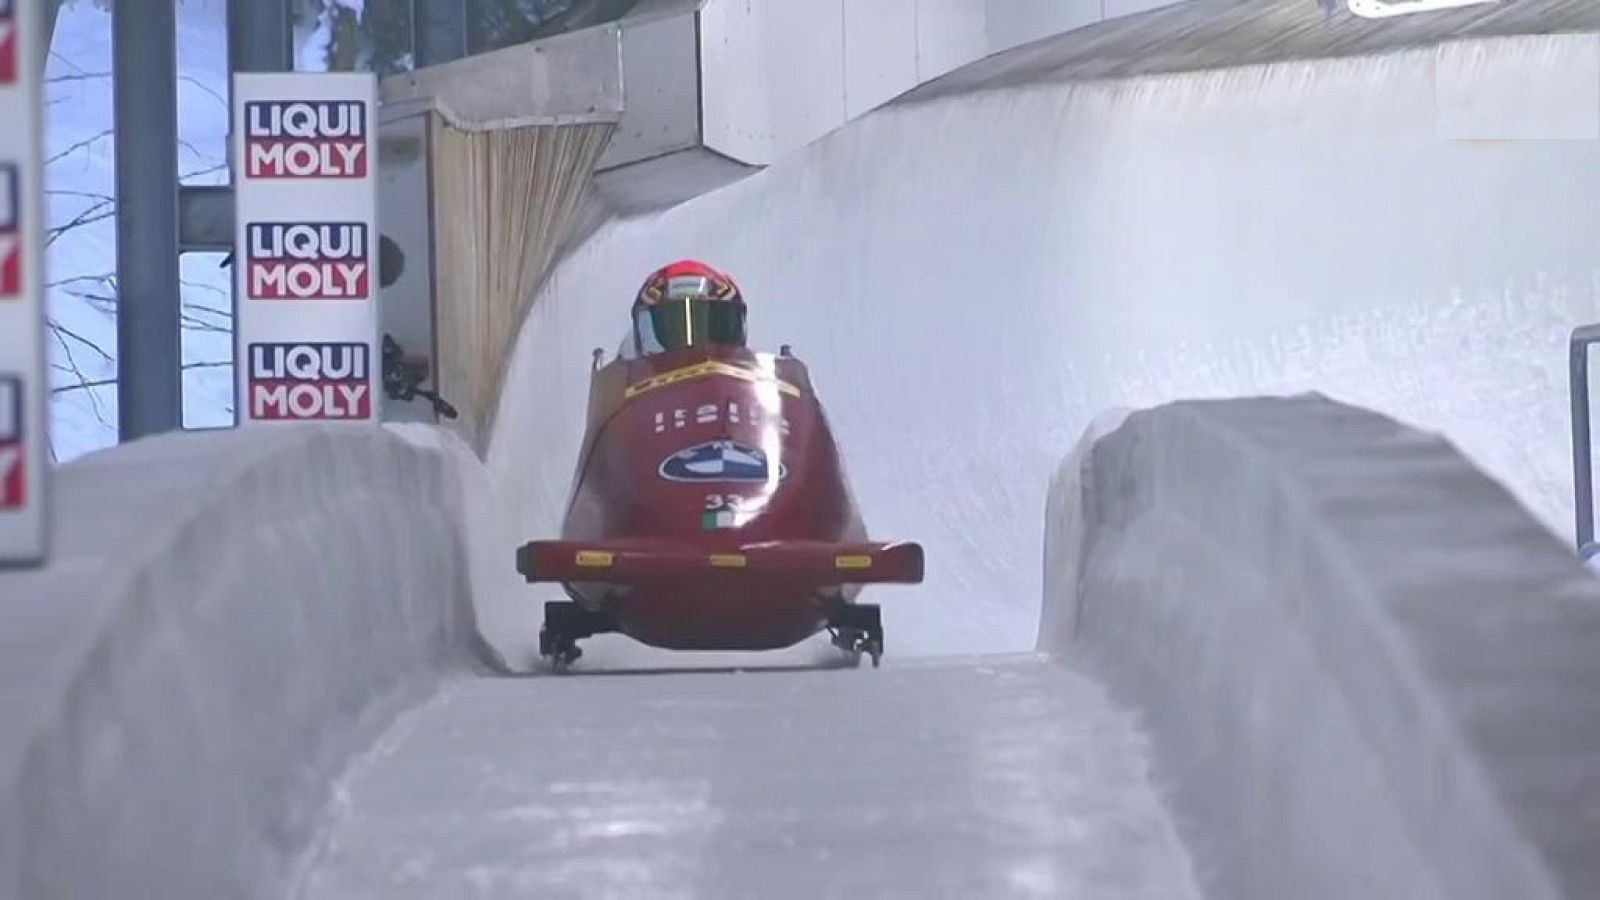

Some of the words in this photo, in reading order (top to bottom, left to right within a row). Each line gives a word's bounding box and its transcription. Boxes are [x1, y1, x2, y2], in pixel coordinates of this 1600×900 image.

[250, 104, 361, 138] LIQUI
[251, 142, 364, 176] MOLY
[252, 224, 362, 259] LIQUI
[253, 263, 366, 297] MOLY
[254, 345, 364, 380] LIQUI
[255, 384, 368, 417] MOLY
